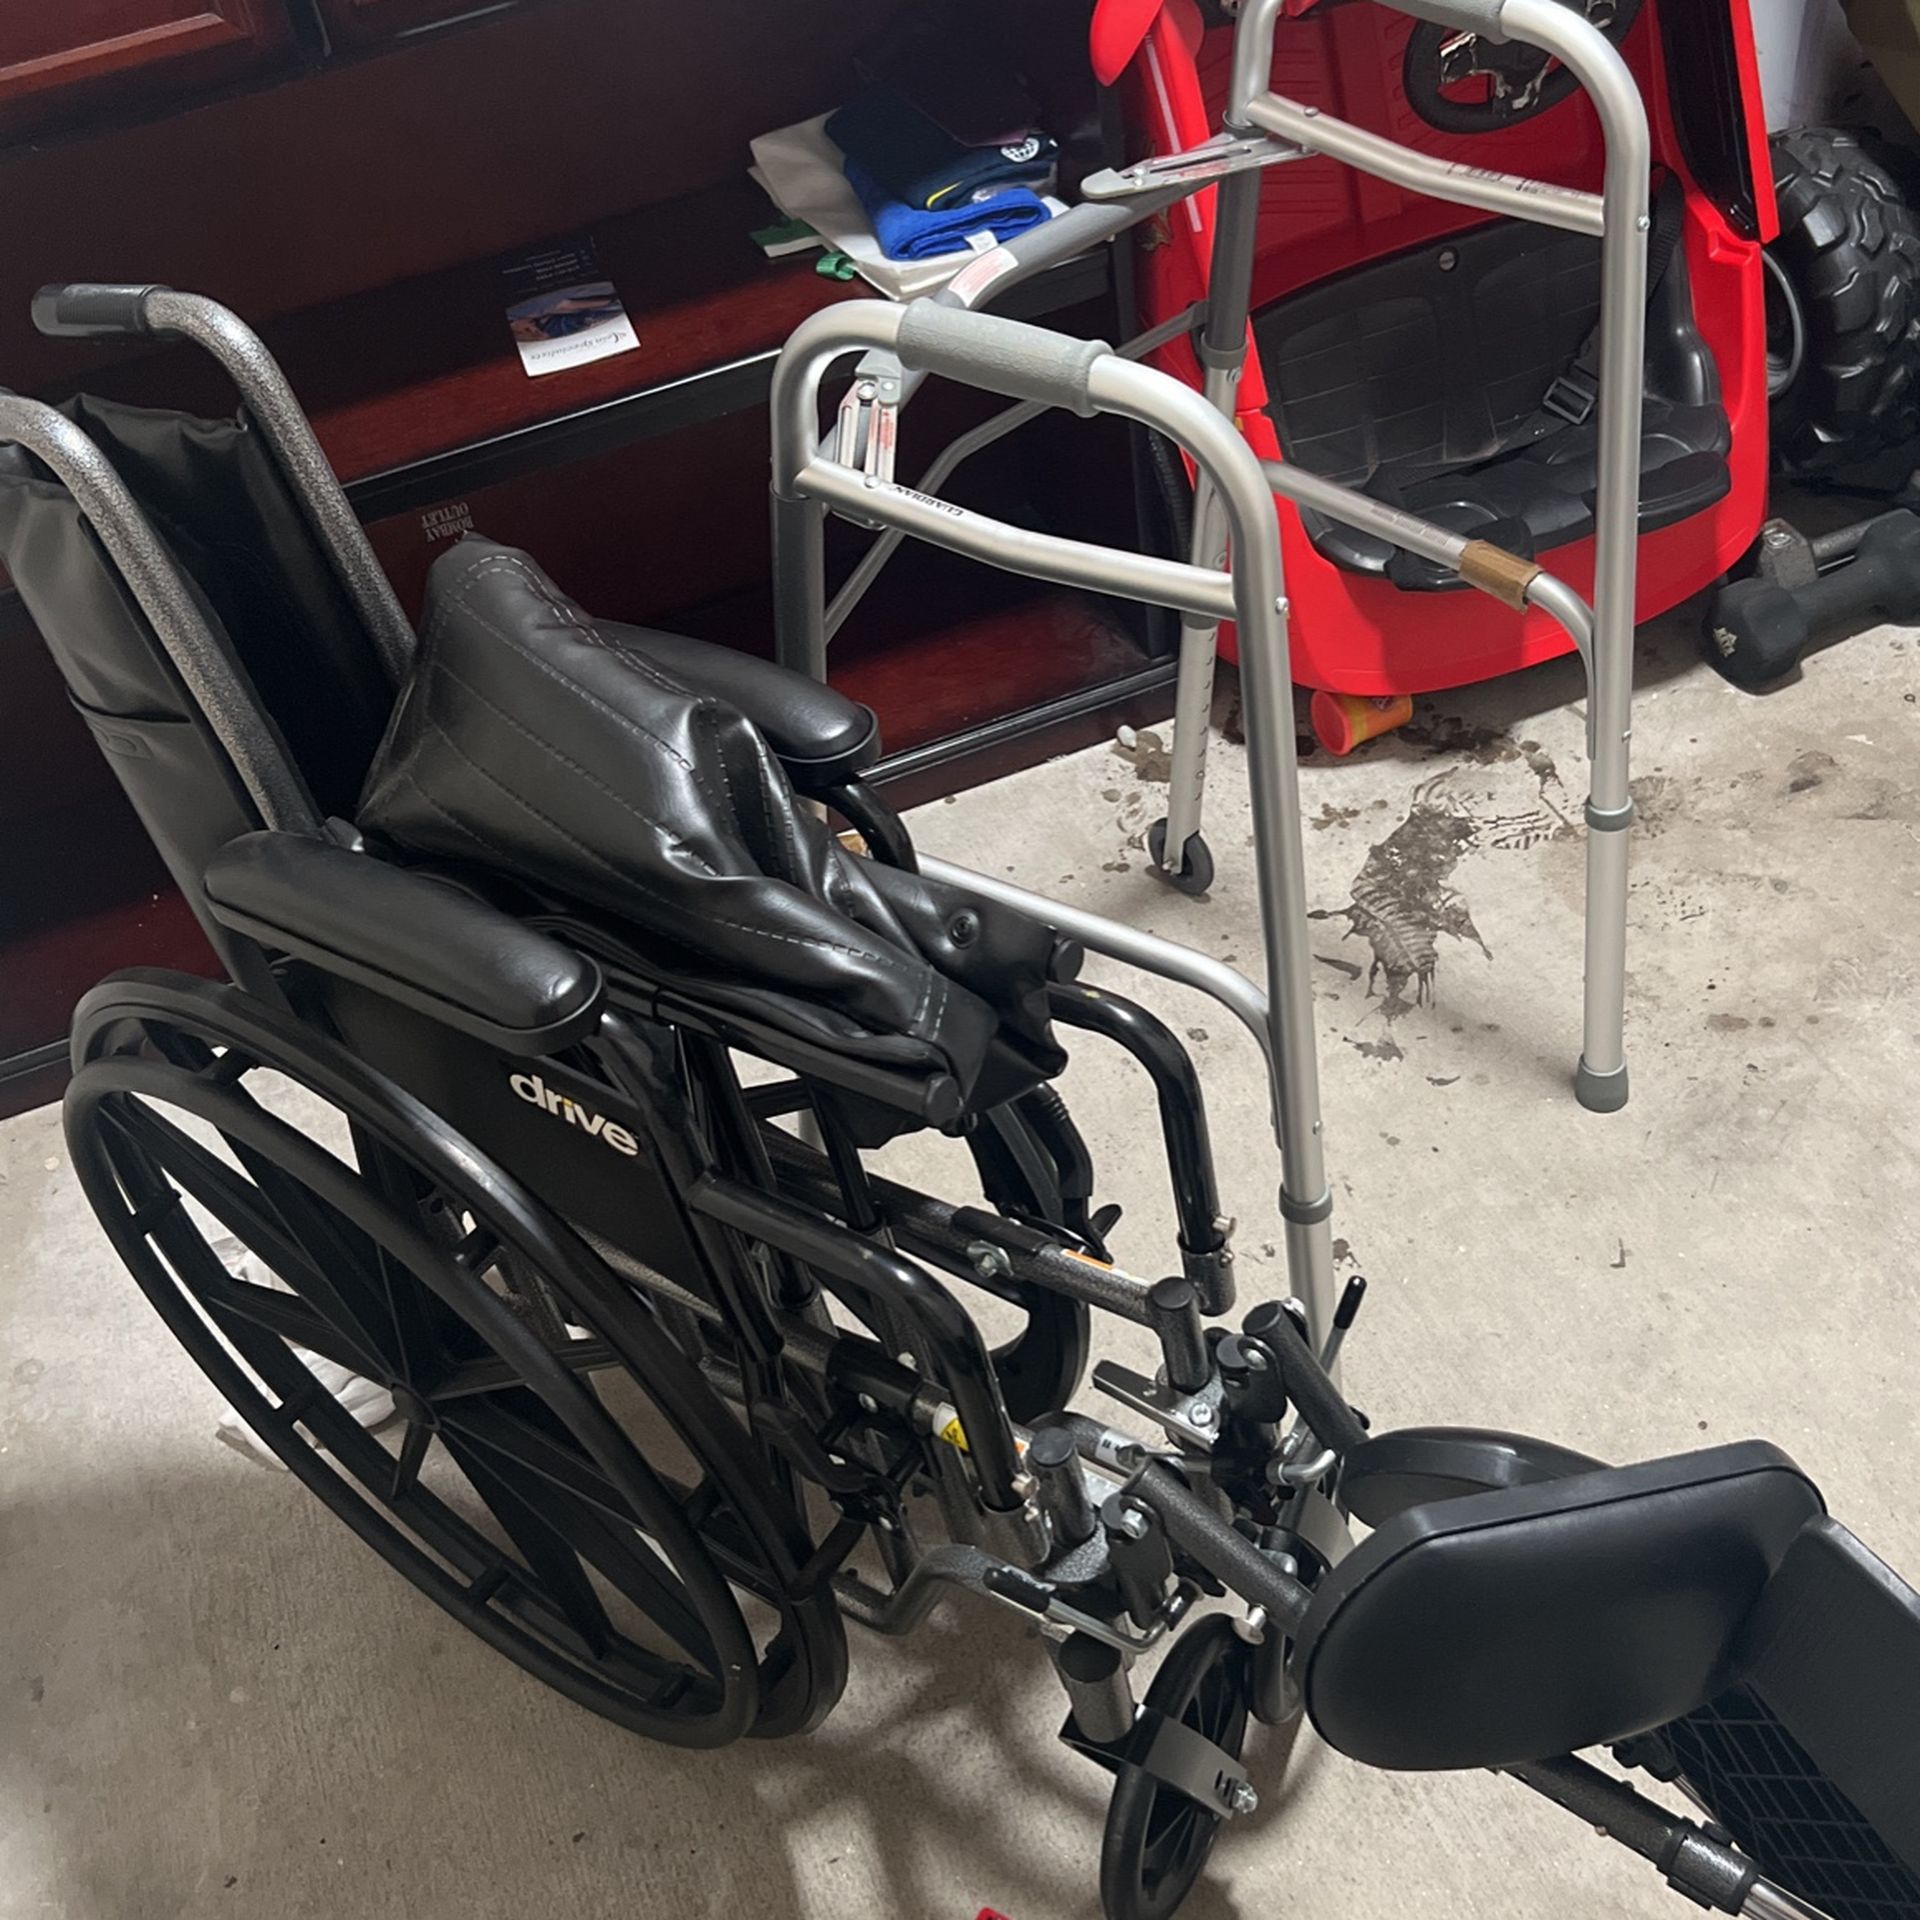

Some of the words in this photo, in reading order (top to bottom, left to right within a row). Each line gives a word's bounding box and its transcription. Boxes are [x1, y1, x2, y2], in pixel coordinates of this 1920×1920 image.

[421, 502, 469, 529] OUTLET
[896, 486, 964, 516] GUARDIAN
[426, 515, 474, 543] BOMBAY
[509, 1073, 639, 1156] drive
